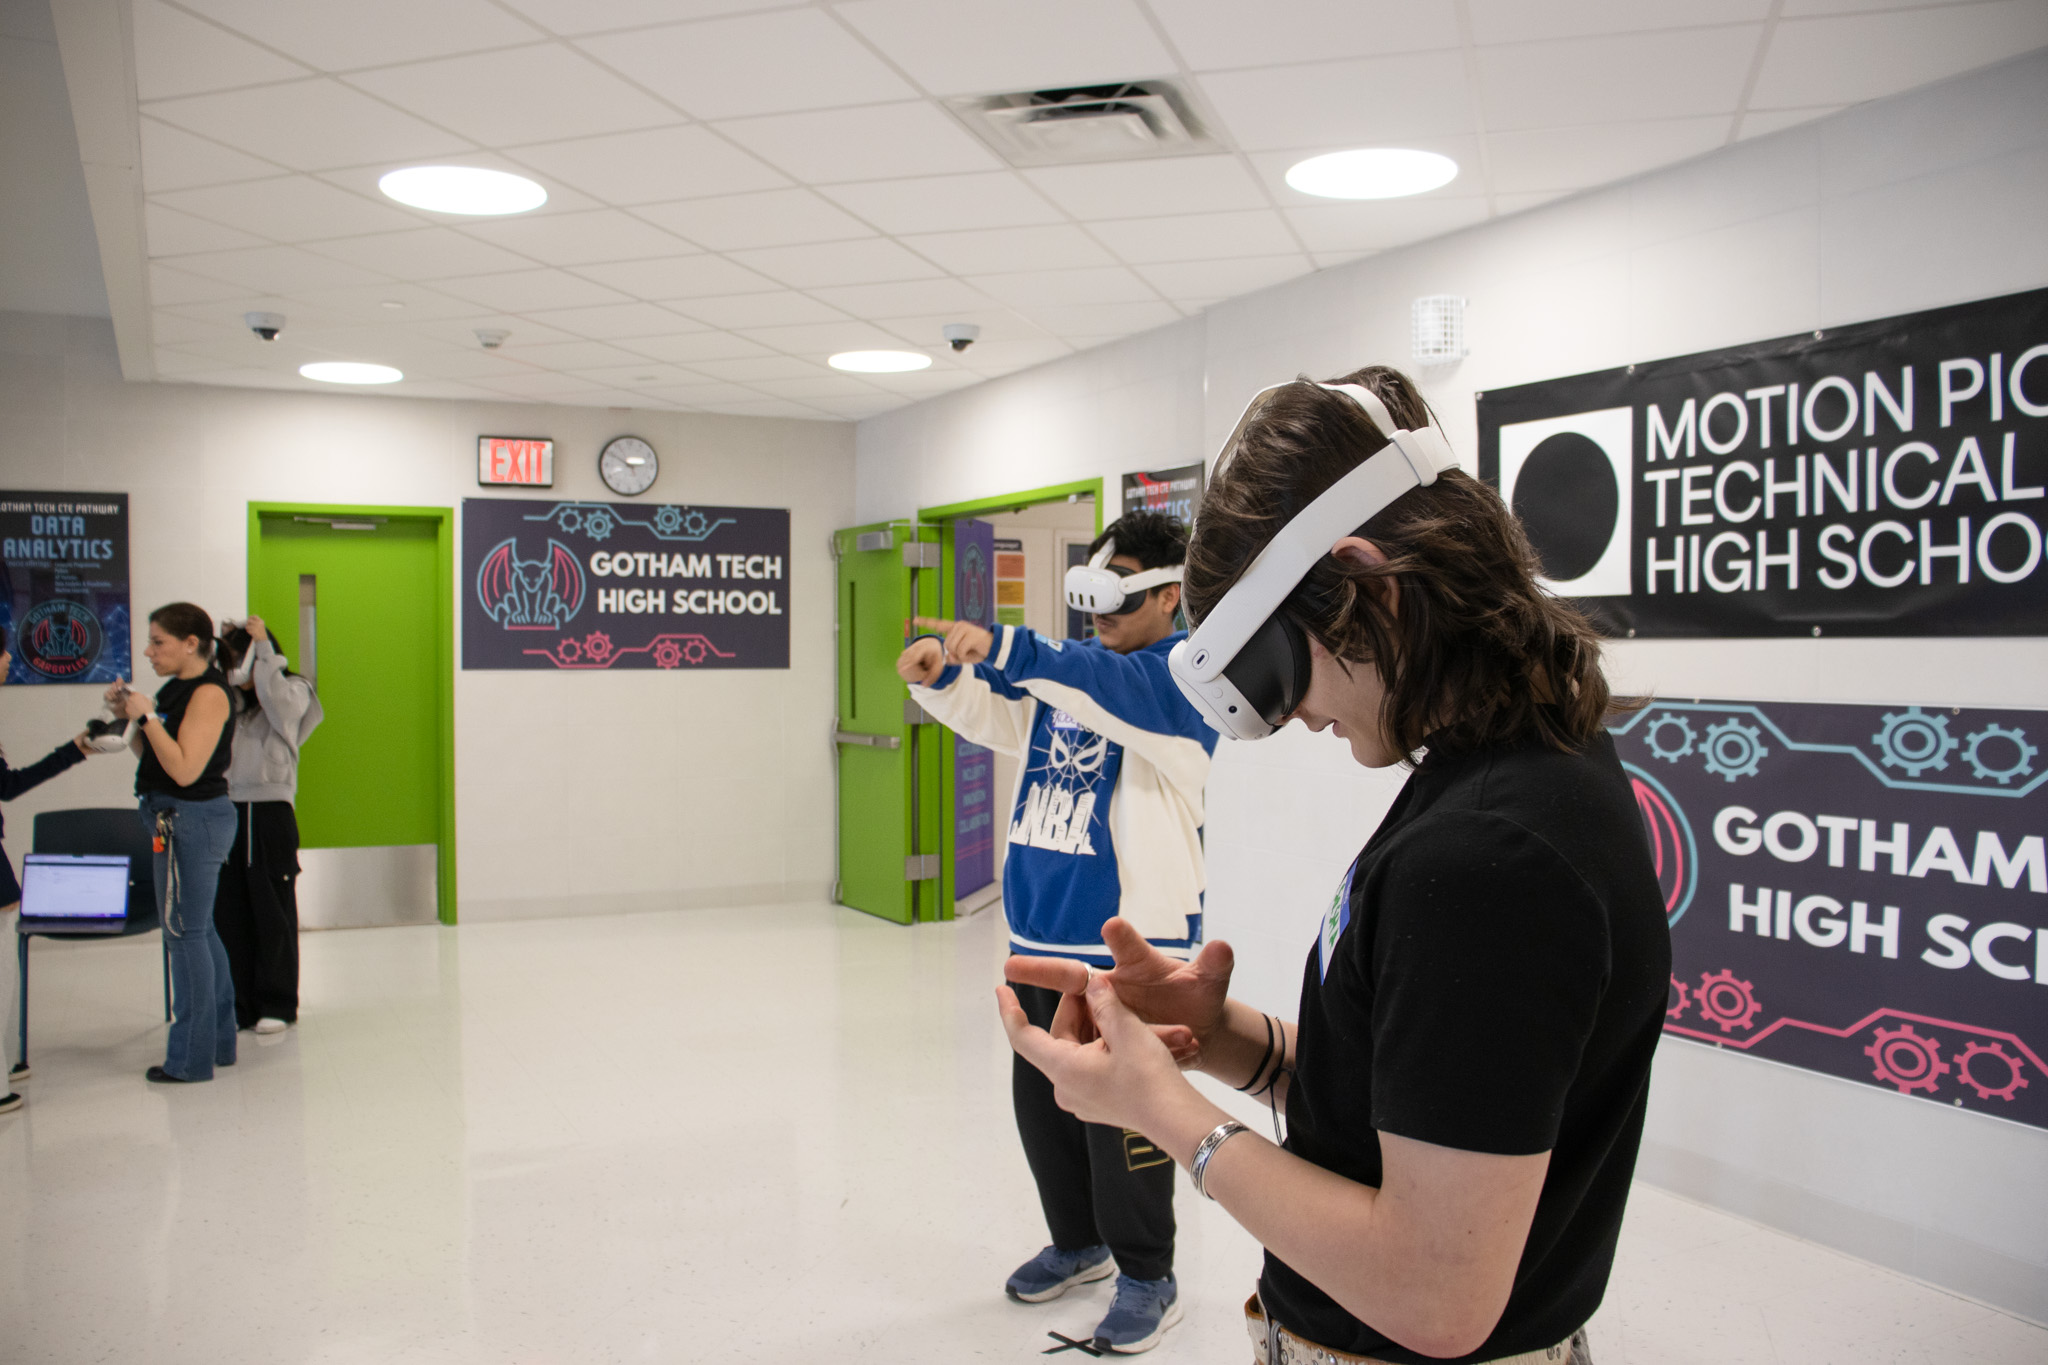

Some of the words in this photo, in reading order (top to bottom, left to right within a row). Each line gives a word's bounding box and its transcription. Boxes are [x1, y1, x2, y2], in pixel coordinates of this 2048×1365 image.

[1646, 363, 1914, 463] MOTION
[489, 438, 546, 483] EXIT
[1643, 432, 2045, 528] TECHNICAL
[0, 502, 31, 513] OTHAM
[34, 503, 56, 513] TECH
[57, 504, 74, 514] CTE
[75, 504, 119, 515] PATHWAY
[31, 515, 85, 536] DATA
[3, 538, 113, 559] ANALYTICS
[589, 551, 712, 579] GOTHAM
[715, 555, 782, 579] TECH
[1647, 528, 1799, 595] HIGH
[1816, 512, 2048, 590] SCHO
[597, 588, 666, 615] HIGH
[671, 589, 782, 616] SCHOOL
[33, 656, 89, 675] GARGOYLES
[1009, 781, 1097, 856] NBA
[1713, 805, 2048, 894] GOTHAM
[1728, 882, 1900, 960] HIGH
